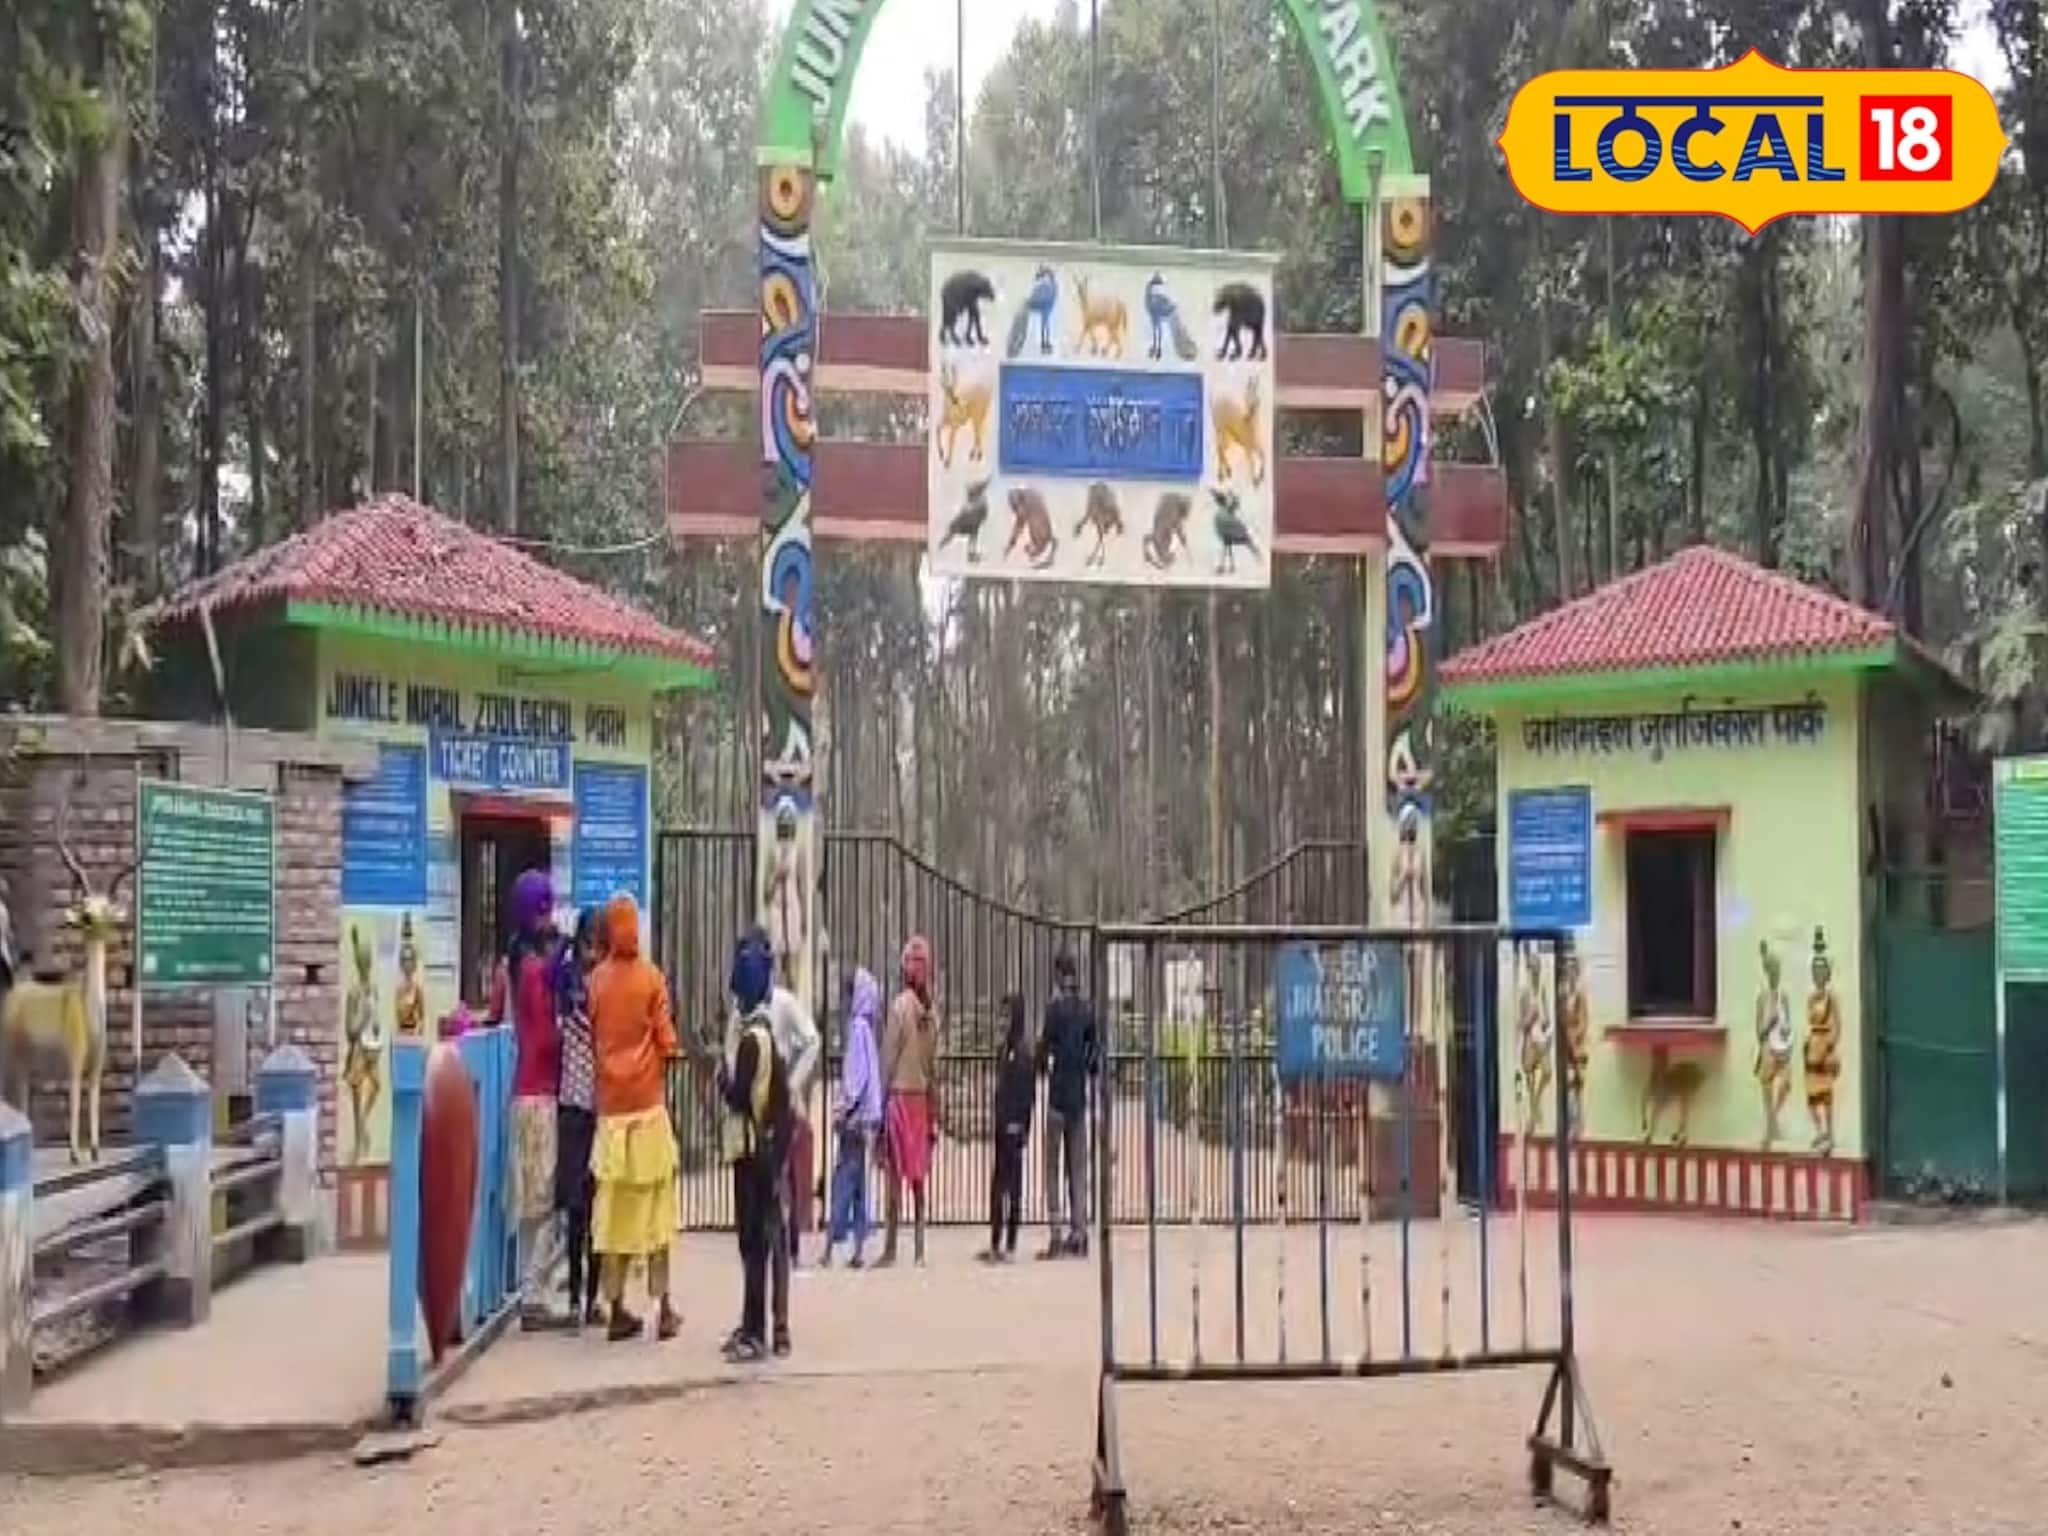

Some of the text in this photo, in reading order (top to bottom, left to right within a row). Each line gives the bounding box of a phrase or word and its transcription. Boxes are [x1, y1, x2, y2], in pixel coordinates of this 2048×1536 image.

[1314, 0, 1391, 138] ARK
[441, 741, 560, 783] TICKET COUNTER
[1312, 1023, 1380, 1061] POLICE
